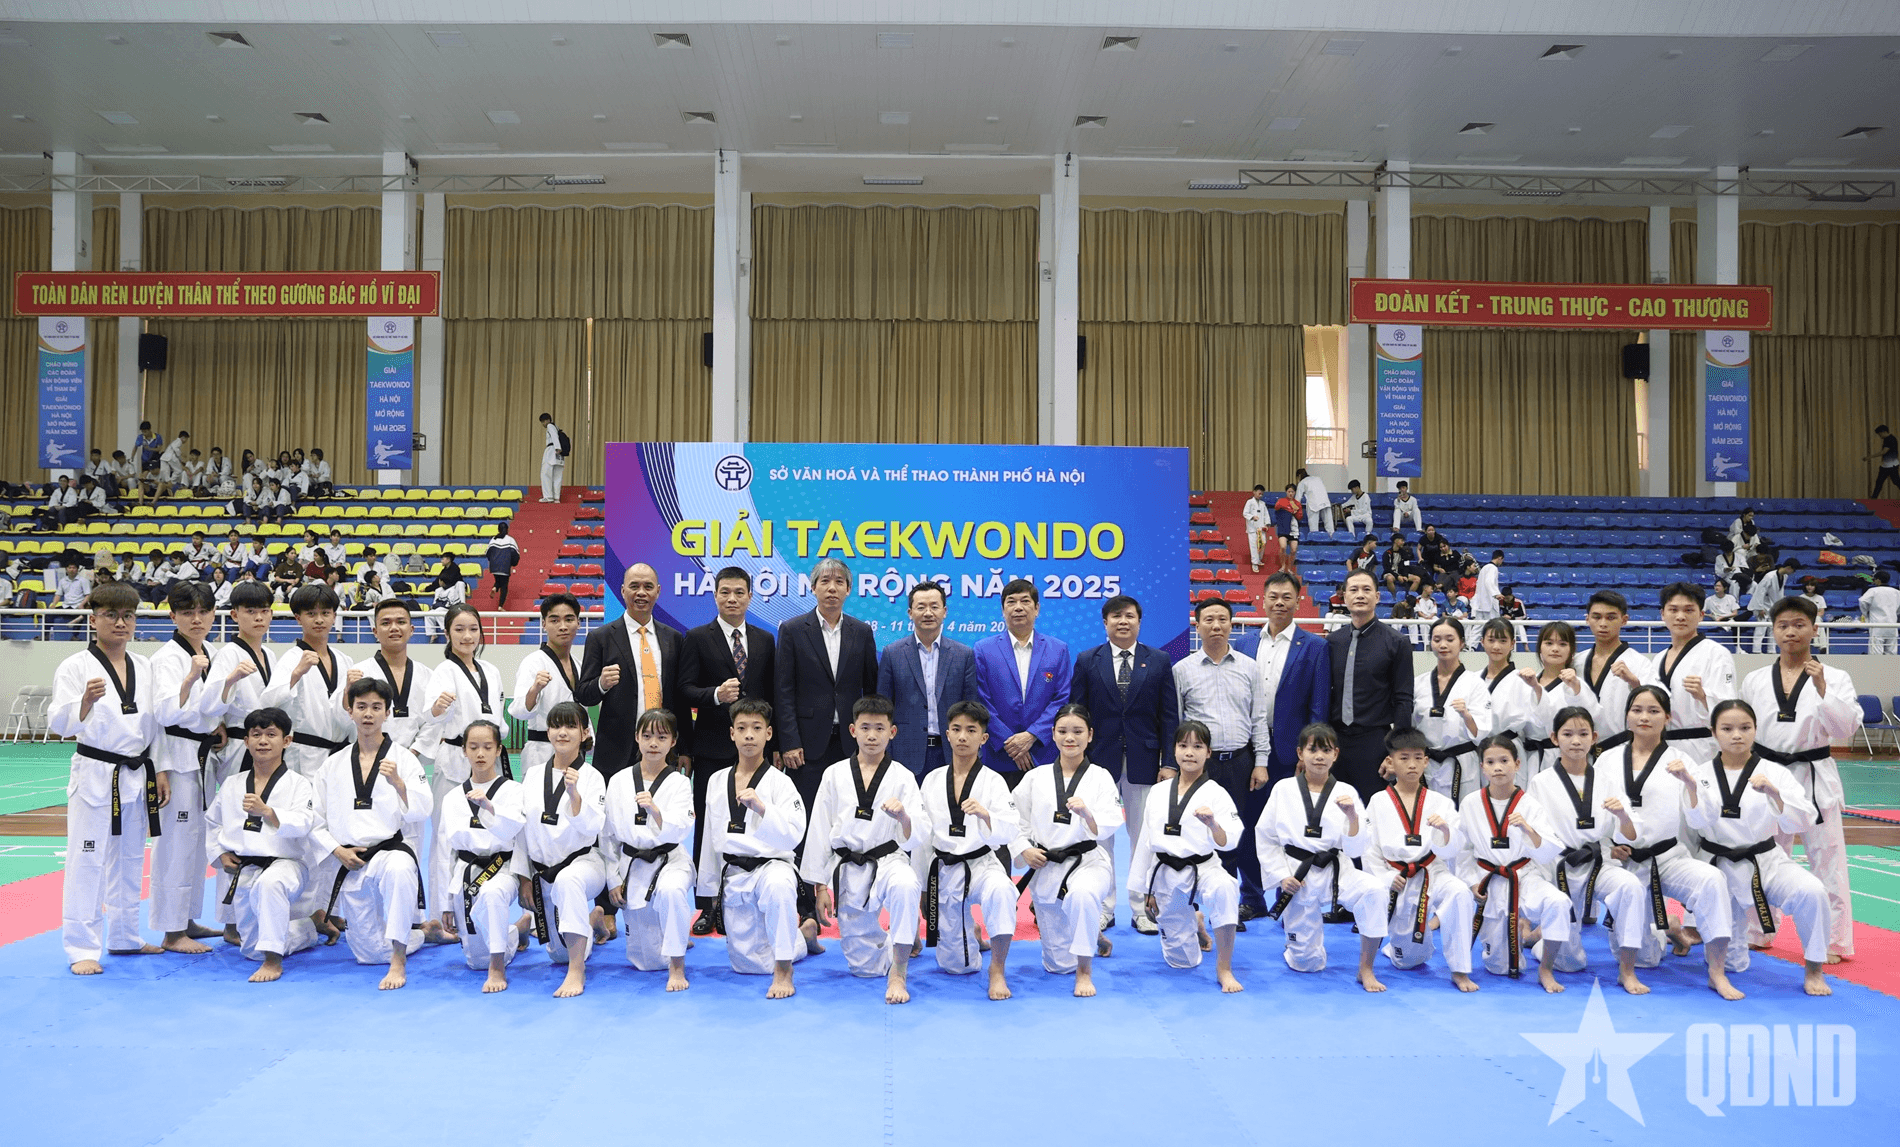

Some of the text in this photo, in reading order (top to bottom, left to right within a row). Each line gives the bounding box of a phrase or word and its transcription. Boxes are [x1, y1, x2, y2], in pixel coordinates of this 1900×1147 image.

[32, 277, 420, 310] TOÀN DÂN RÈN LUYỆN THÂN THỂ THEO GƯƠNG BÁC HỒ VĨ ĐẠI
[1375, 290, 1429, 313] ĐOÀN
[1435, 289, 1470, 313] KẾT
[1490, 296, 1553, 316] TRUNG
[1559, 296, 1608, 320] THỰC
[1629, 298, 1666, 317] CAO
[1672, 297, 1749, 322] THƯỢNG
[384, 365, 396, 374] GIẢI
[370, 381, 410, 389] TAEKWONDO
[379, 394, 401, 404] HÀ NỘI
[375, 408, 405, 419] MỞ RỘNG
[374, 424, 388, 432] NĂM
[1724, 423, 1742, 432] RỘNG
[770, 464, 1085, 486] SỞ VĂN HOÁ VÀ THỂ THAO THÀNH PHỐ HÀ NỘI
[672, 509, 1125, 560] GIẢI TAEKWONDO
[674, 567, 716, 596] HÀ
[754, 567, 788, 602] ỘI
[1043, 574, 1121, 598] 2025
[890, 620, 903, 632] 11
[947, 621, 955, 632] 4
[959, 621, 986, 632] năm
